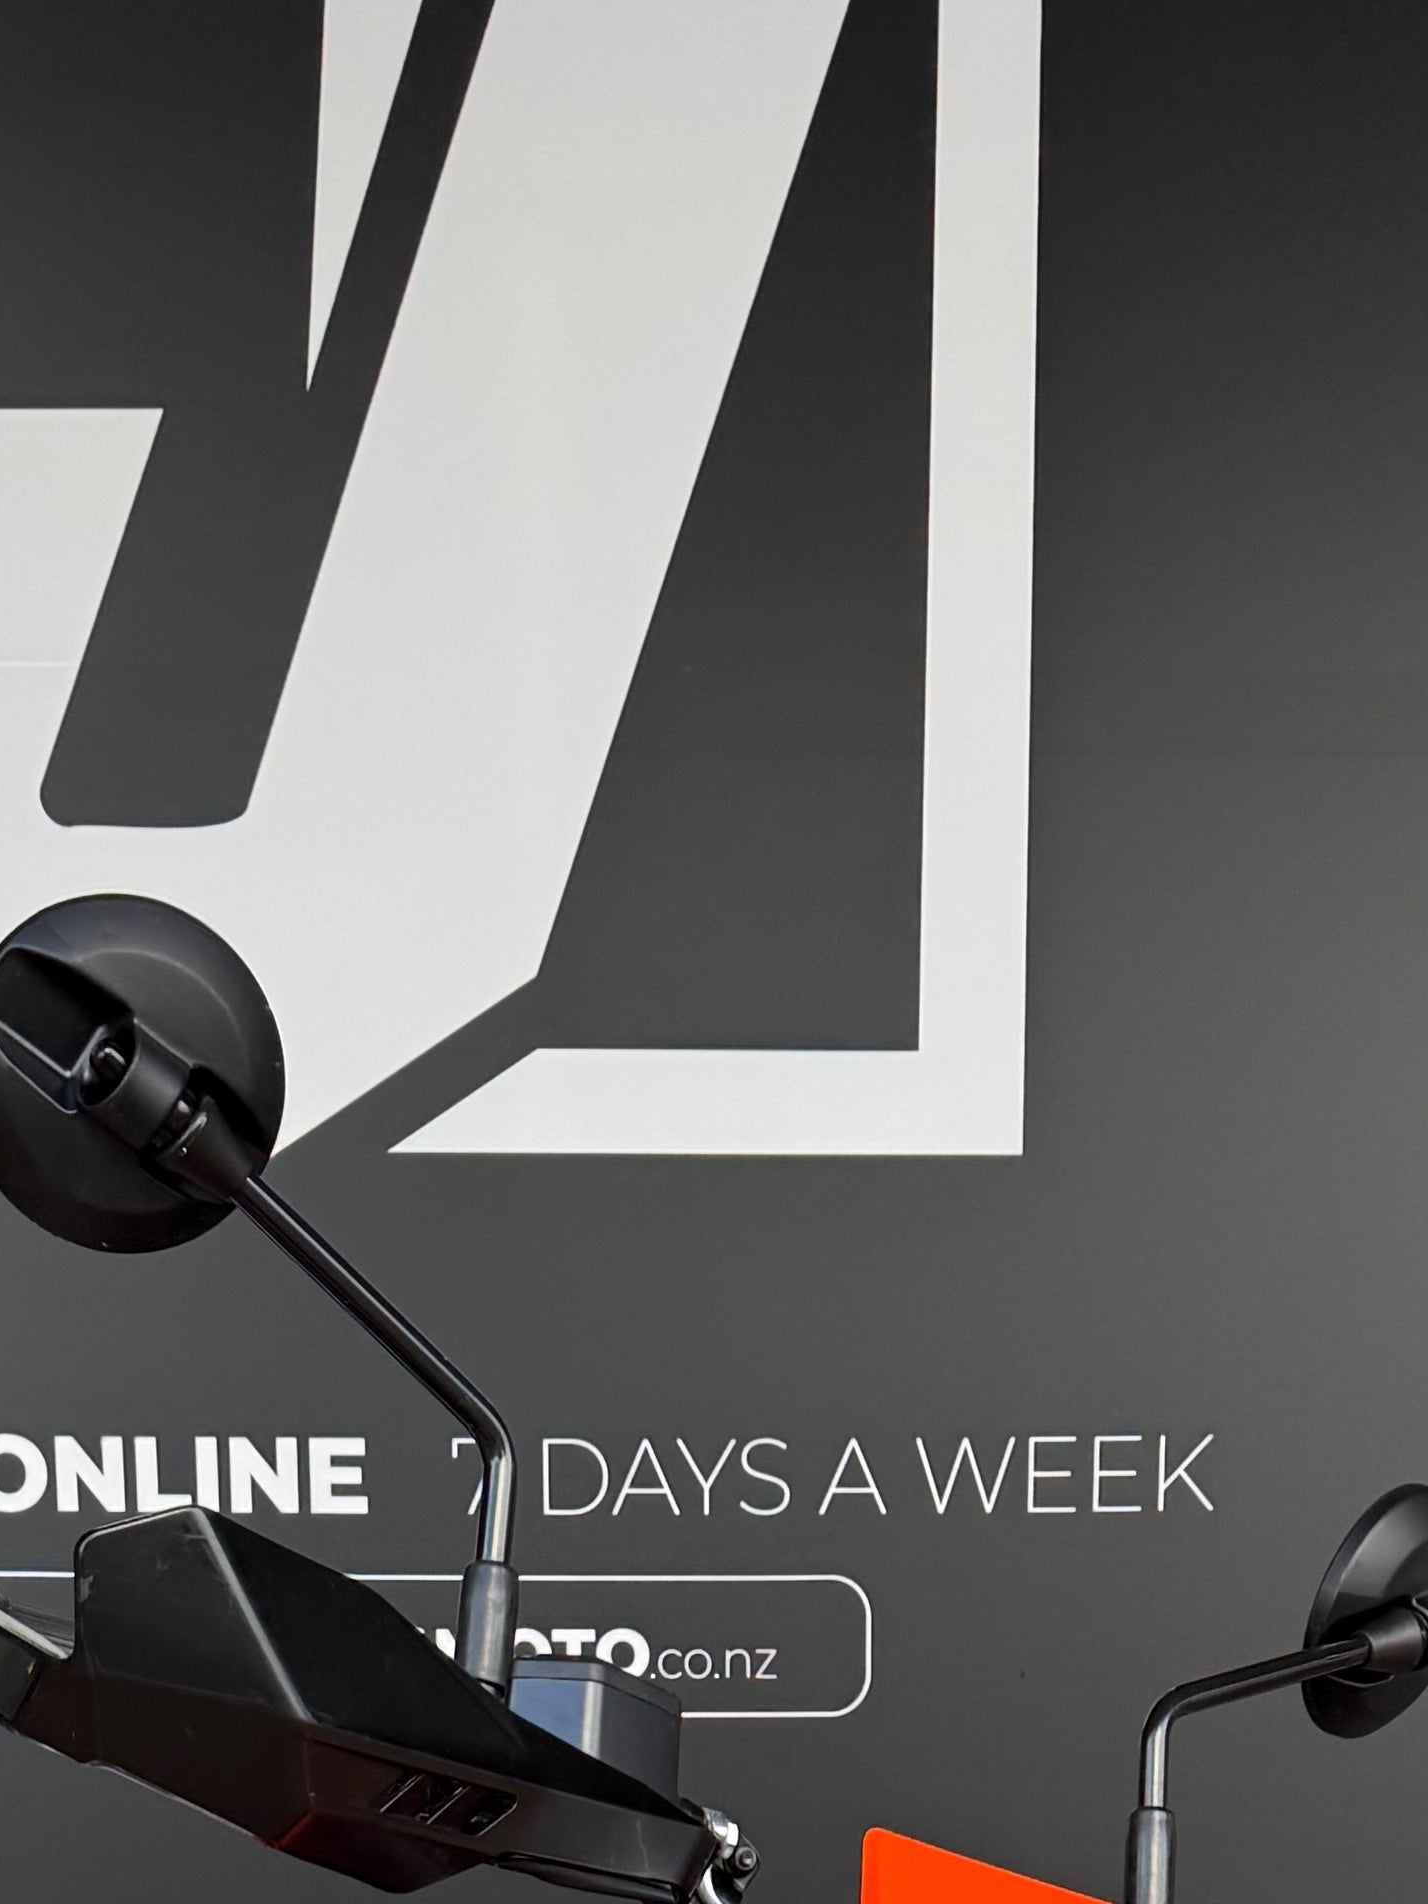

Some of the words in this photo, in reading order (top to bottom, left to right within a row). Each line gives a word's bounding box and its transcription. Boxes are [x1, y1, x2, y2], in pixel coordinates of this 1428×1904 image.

[543, 1437, 791, 1516] DAYS
[819, 1437, 887, 1516] A
[916, 1434, 1214, 1515] WEEK
